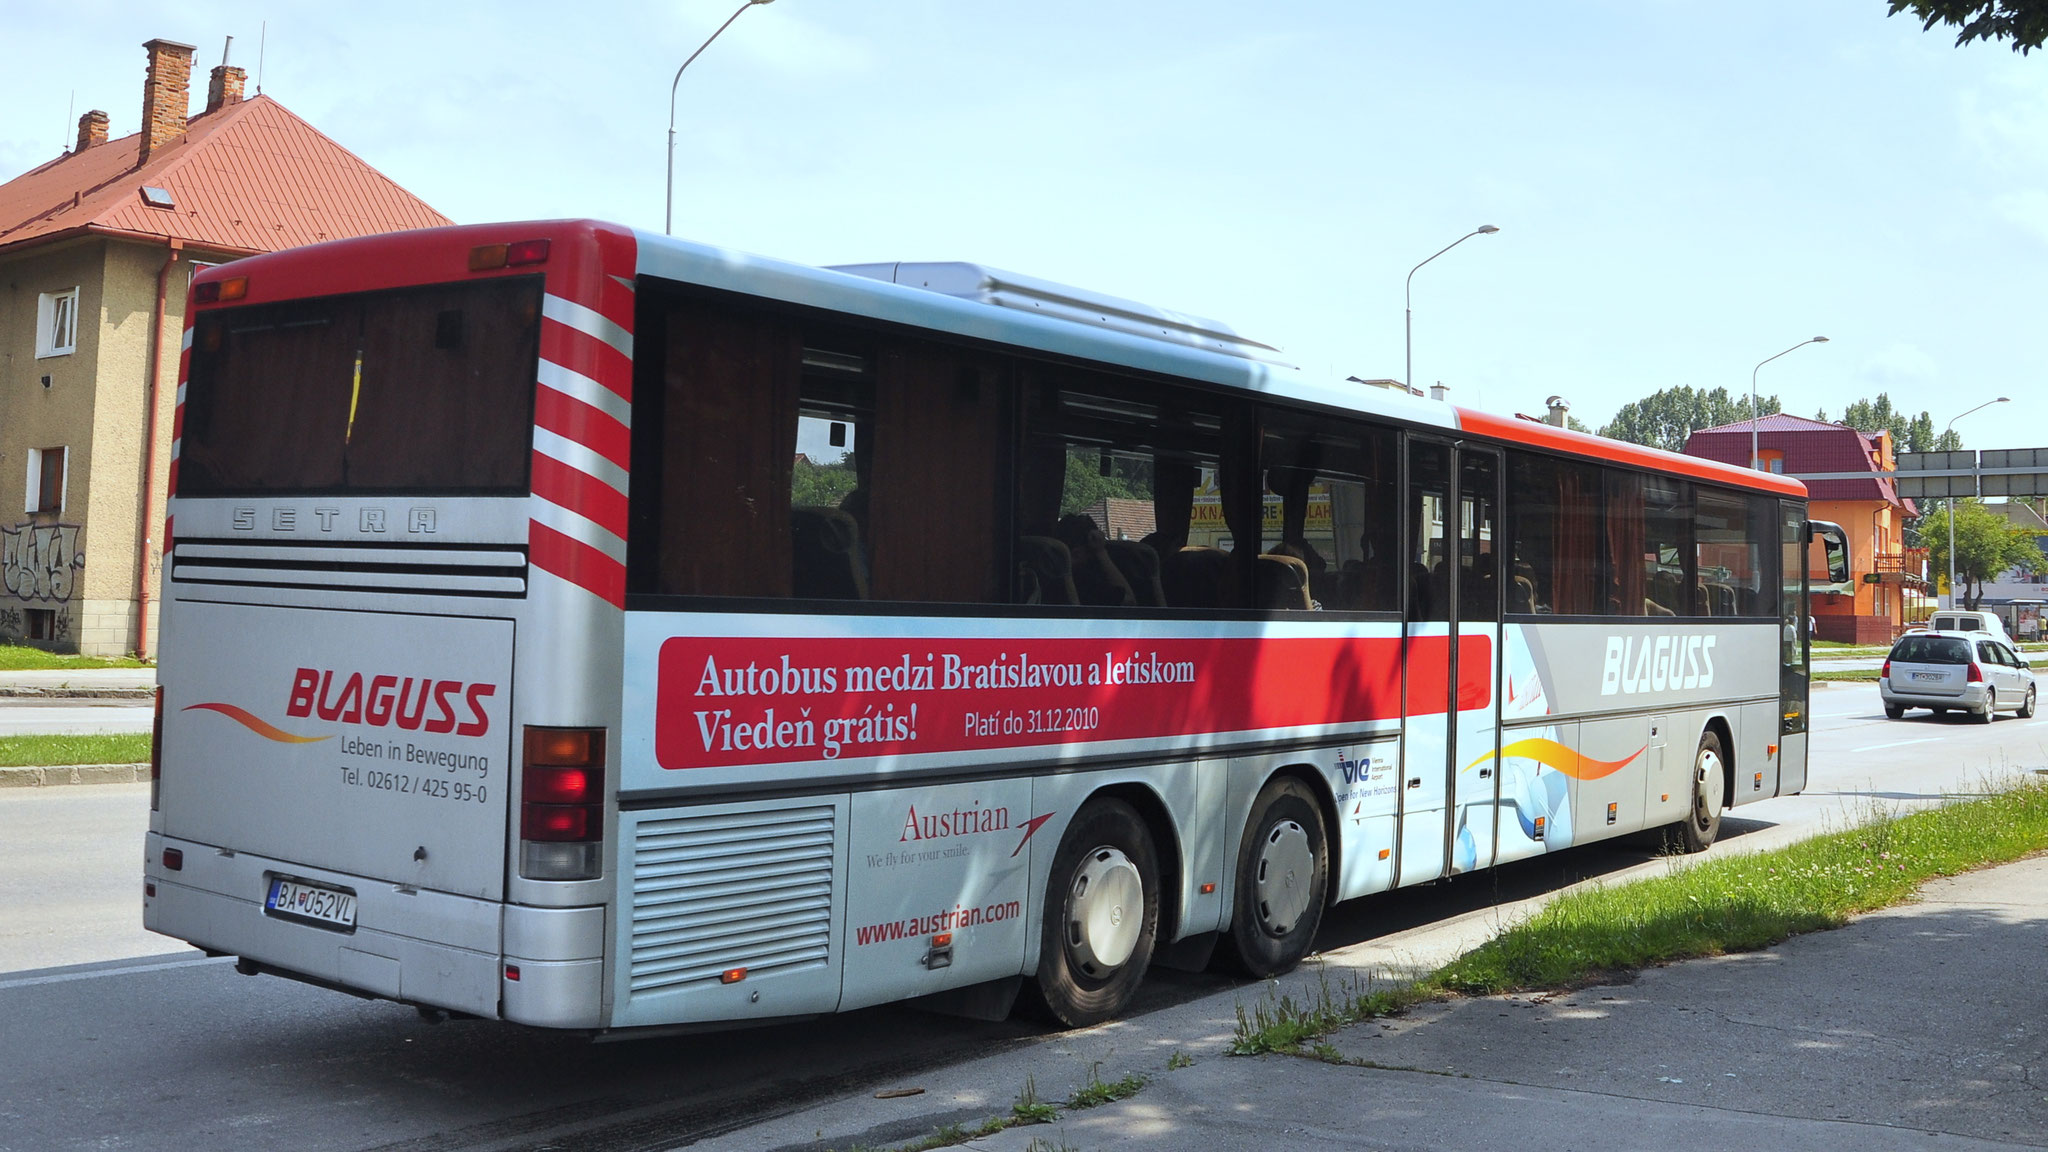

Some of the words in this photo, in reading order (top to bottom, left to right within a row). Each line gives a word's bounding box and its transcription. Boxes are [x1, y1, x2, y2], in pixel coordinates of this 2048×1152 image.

[233, 506, 437, 533] SETRA
[694, 654, 838, 696] Autobus
[844, 653, 935, 693] medzi
[940, 653, 1083, 690] Bratislavou
[1087, 663, 1101, 686] a
[1104, 651, 1196, 685] letiskom
[1600, 634, 1717, 696] BLAGUSS
[286, 667, 497, 738] BLAGUSS
[965, 710, 1000, 737] Platí
[1003, 710, 1023, 735] do
[1026, 706, 1099, 733] 31.12.2010
[693, 706, 816, 752] Viedeň
[822, 702, 918, 760] grátis!
[341, 735, 383, 759] Leben
[388, 740, 401, 761] in
[406, 743, 489, 779] Bewegung
[341, 766, 363, 786] Tel.
[367, 770, 409, 793] 02612
[422, 778, 449, 798] 425
[453, 782, 487, 804] 95-0
[899, 799, 1010, 842] Austrian
[867, 855, 883, 868] We
[885, 852, 897, 871] fly
[900, 850, 914, 865] for
[917, 850, 941, 867] your
[942, 843, 970, 859] smile.
[856, 900, 1020, 946] www.austrian.com
